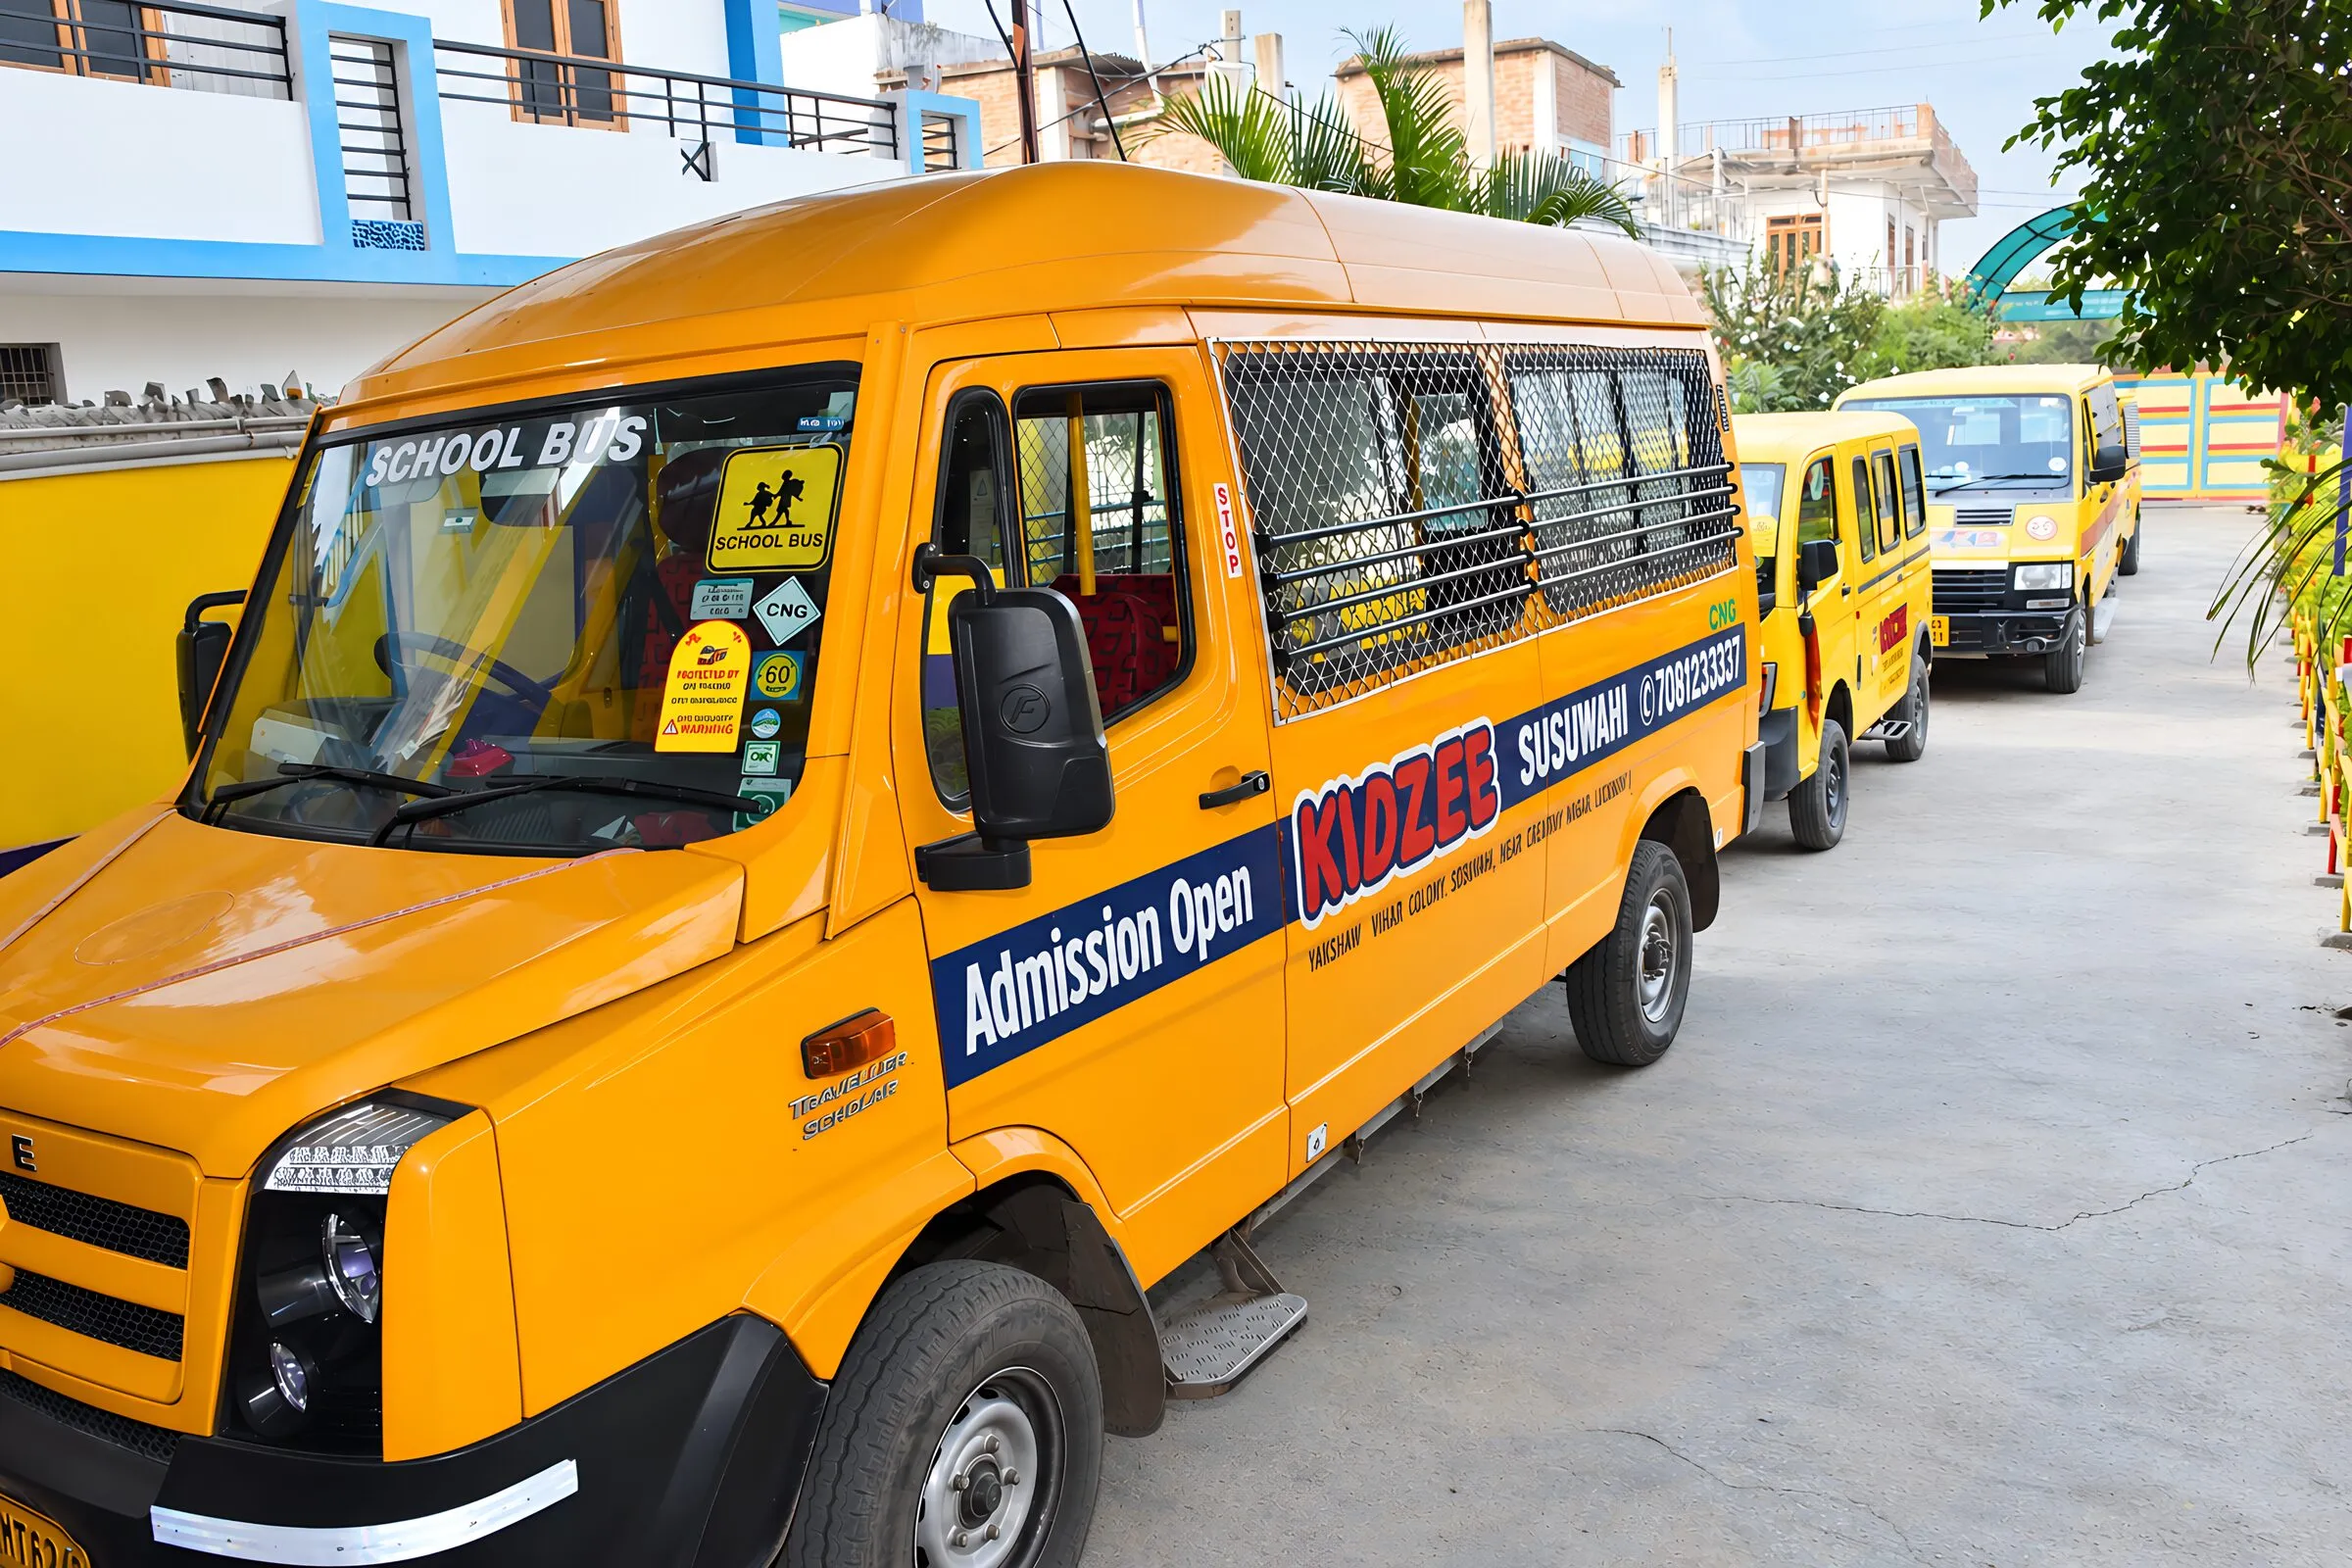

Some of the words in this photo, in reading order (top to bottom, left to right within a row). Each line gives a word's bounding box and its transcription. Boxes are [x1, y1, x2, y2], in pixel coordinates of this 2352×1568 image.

[366, 427, 523, 487] SCHOOL
[536, 416, 647, 465] BUS
[714, 533, 784, 551] SCHOOL
[788, 533, 823, 548] BUS
[1217, 487, 1239, 574] STOP
[766, 603, 808, 618] CNG
[1709, 599, 1737, 630] CNG
[765, 665, 790, 684] 60
[1518, 684, 1628, 786] SUSUWAHI
[1297, 722, 1500, 922] KIDZEE
[966, 905, 1163, 1056] Admission
[1170, 865, 1253, 961] Open
